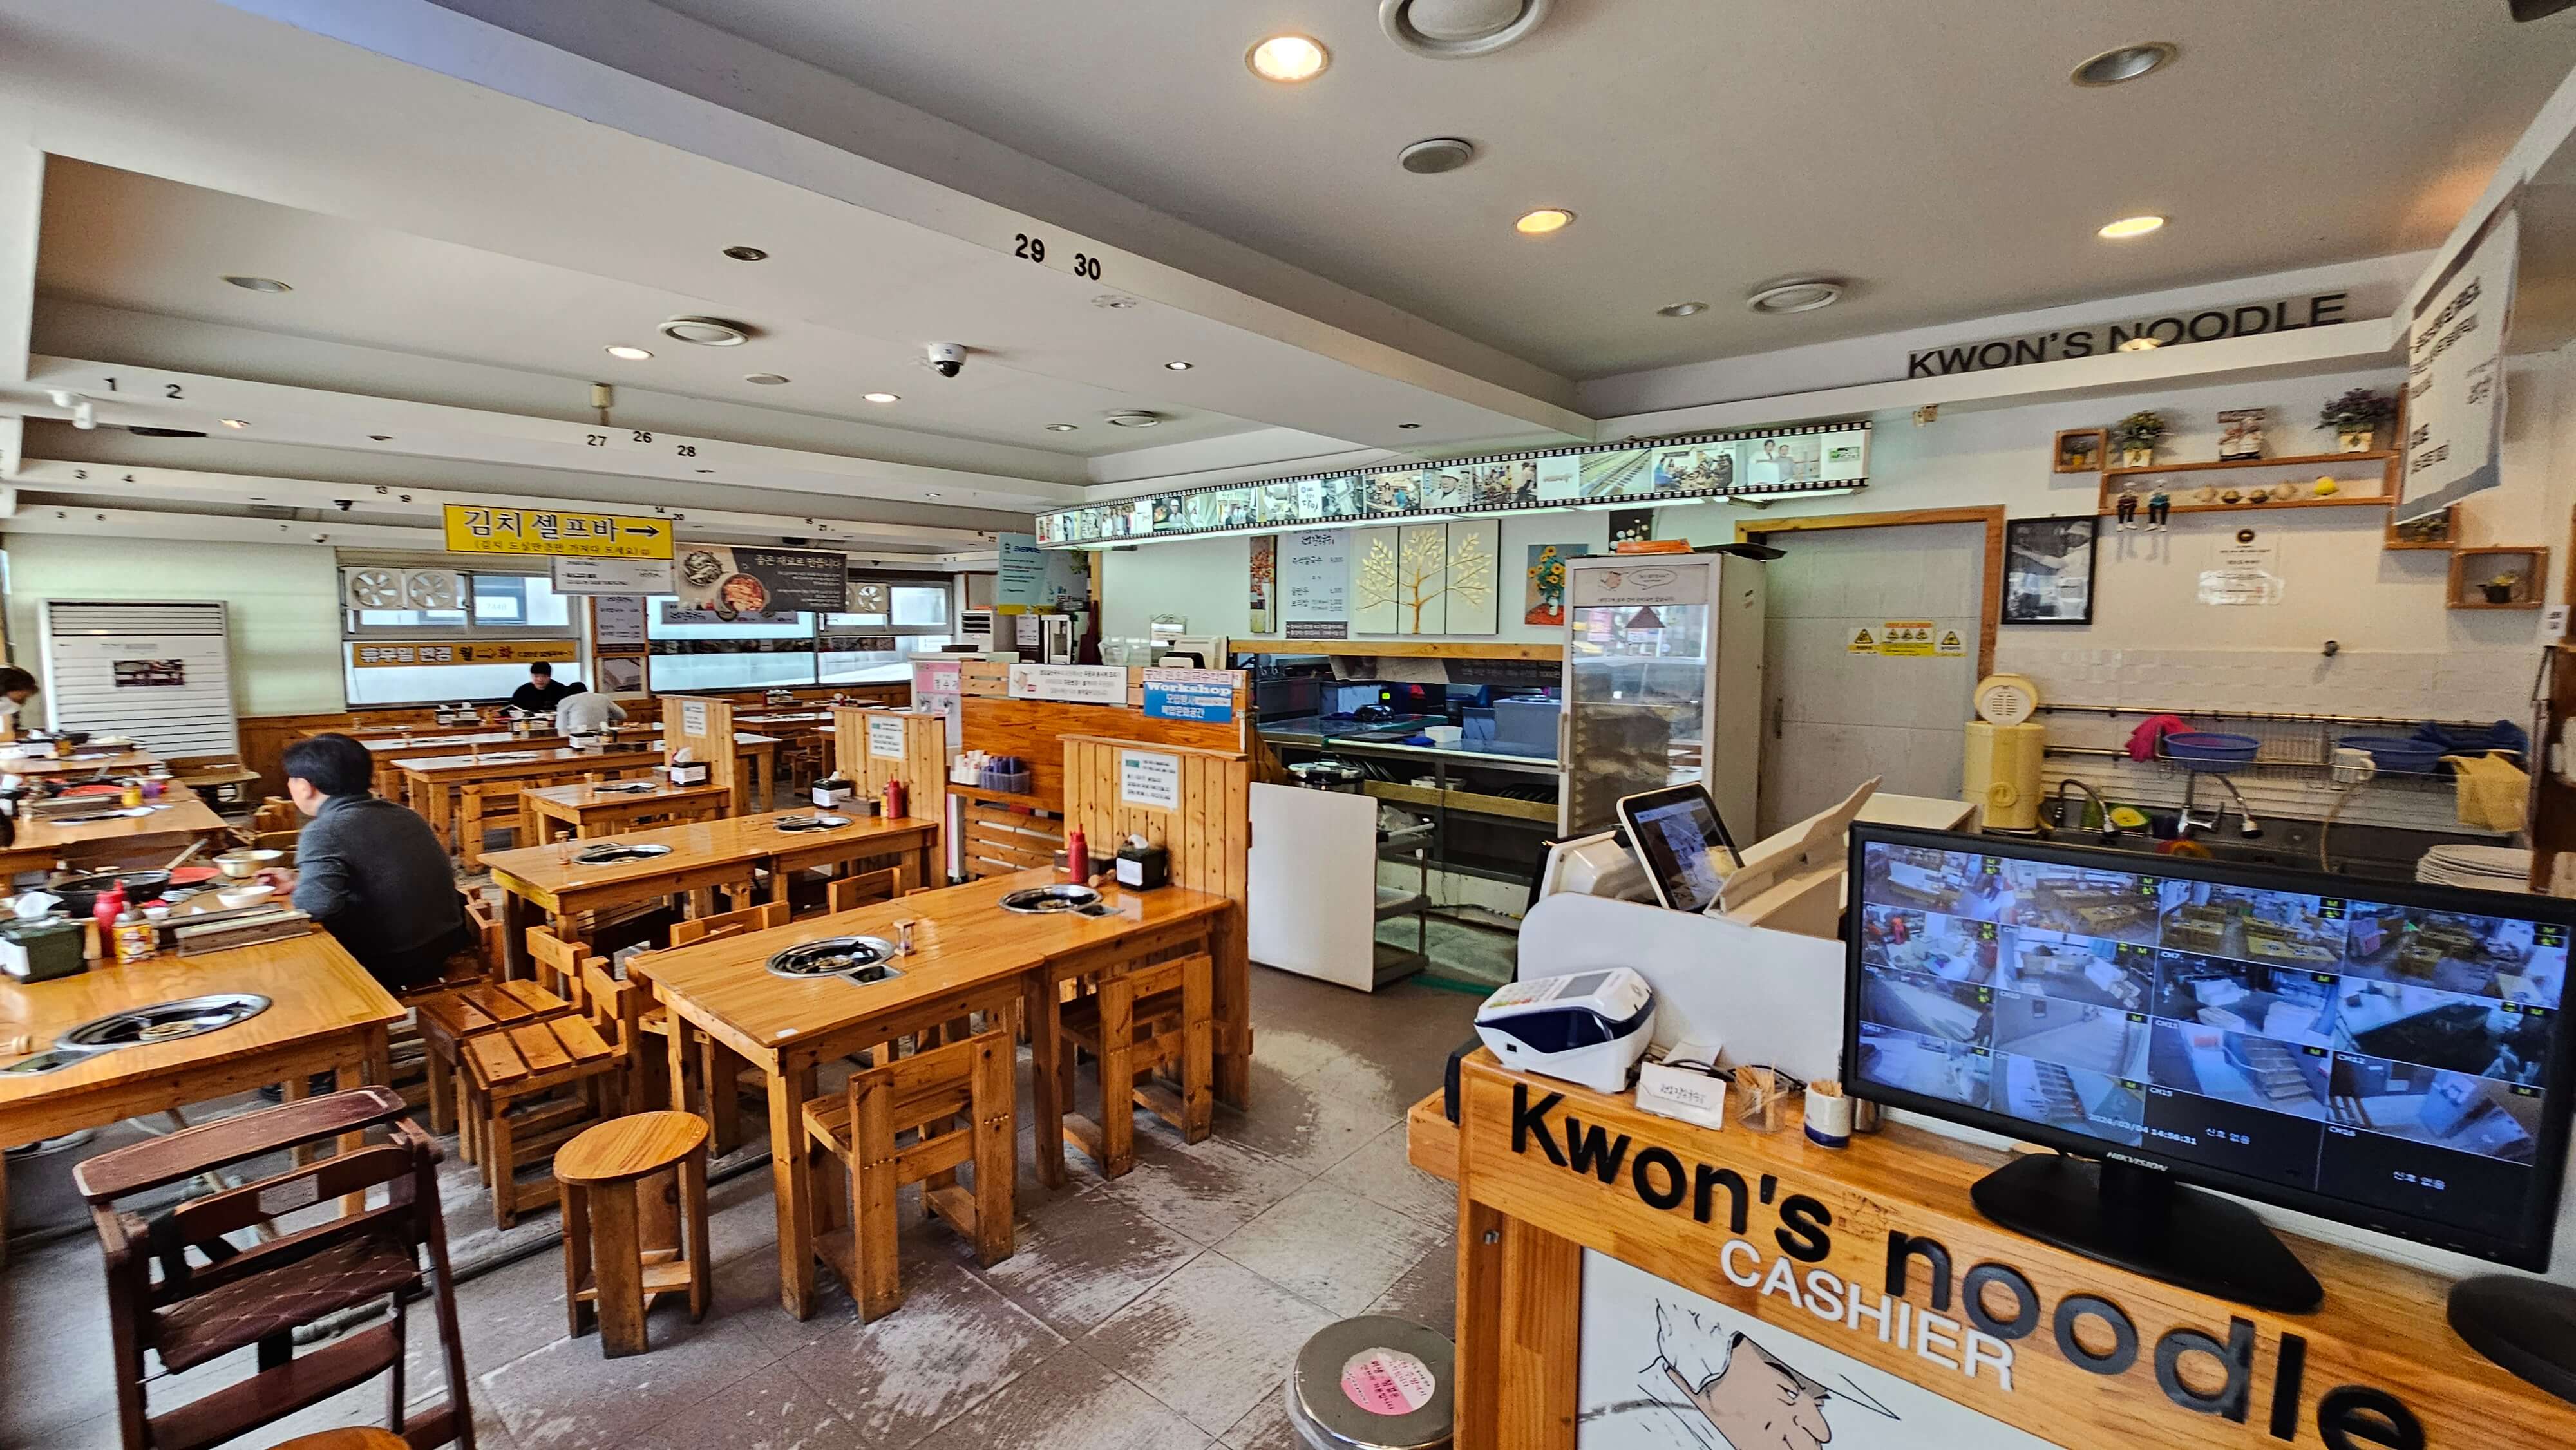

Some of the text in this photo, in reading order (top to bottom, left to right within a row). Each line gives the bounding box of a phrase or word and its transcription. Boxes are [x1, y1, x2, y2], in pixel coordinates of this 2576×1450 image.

[1014, 233, 1101, 281] 29 30
[1908, 293, 2347, 379] KWON'S NOODLE
[103, 377, 185, 399] 1 2
[587, 431, 696, 457] 27 26 28
[73, 469, 88, 479] 3
[464, 509, 621, 543] 김치 셀프바
[755, 554, 775, 566] 좋은
[1145, 682, 1232, 697] Workshop
[2106, 1151, 2169, 1172] HIKVISION
[1511, 1082, 2426, 1450] Kwon's noodle
[1720, 1239, 2015, 1393] CASHIER
